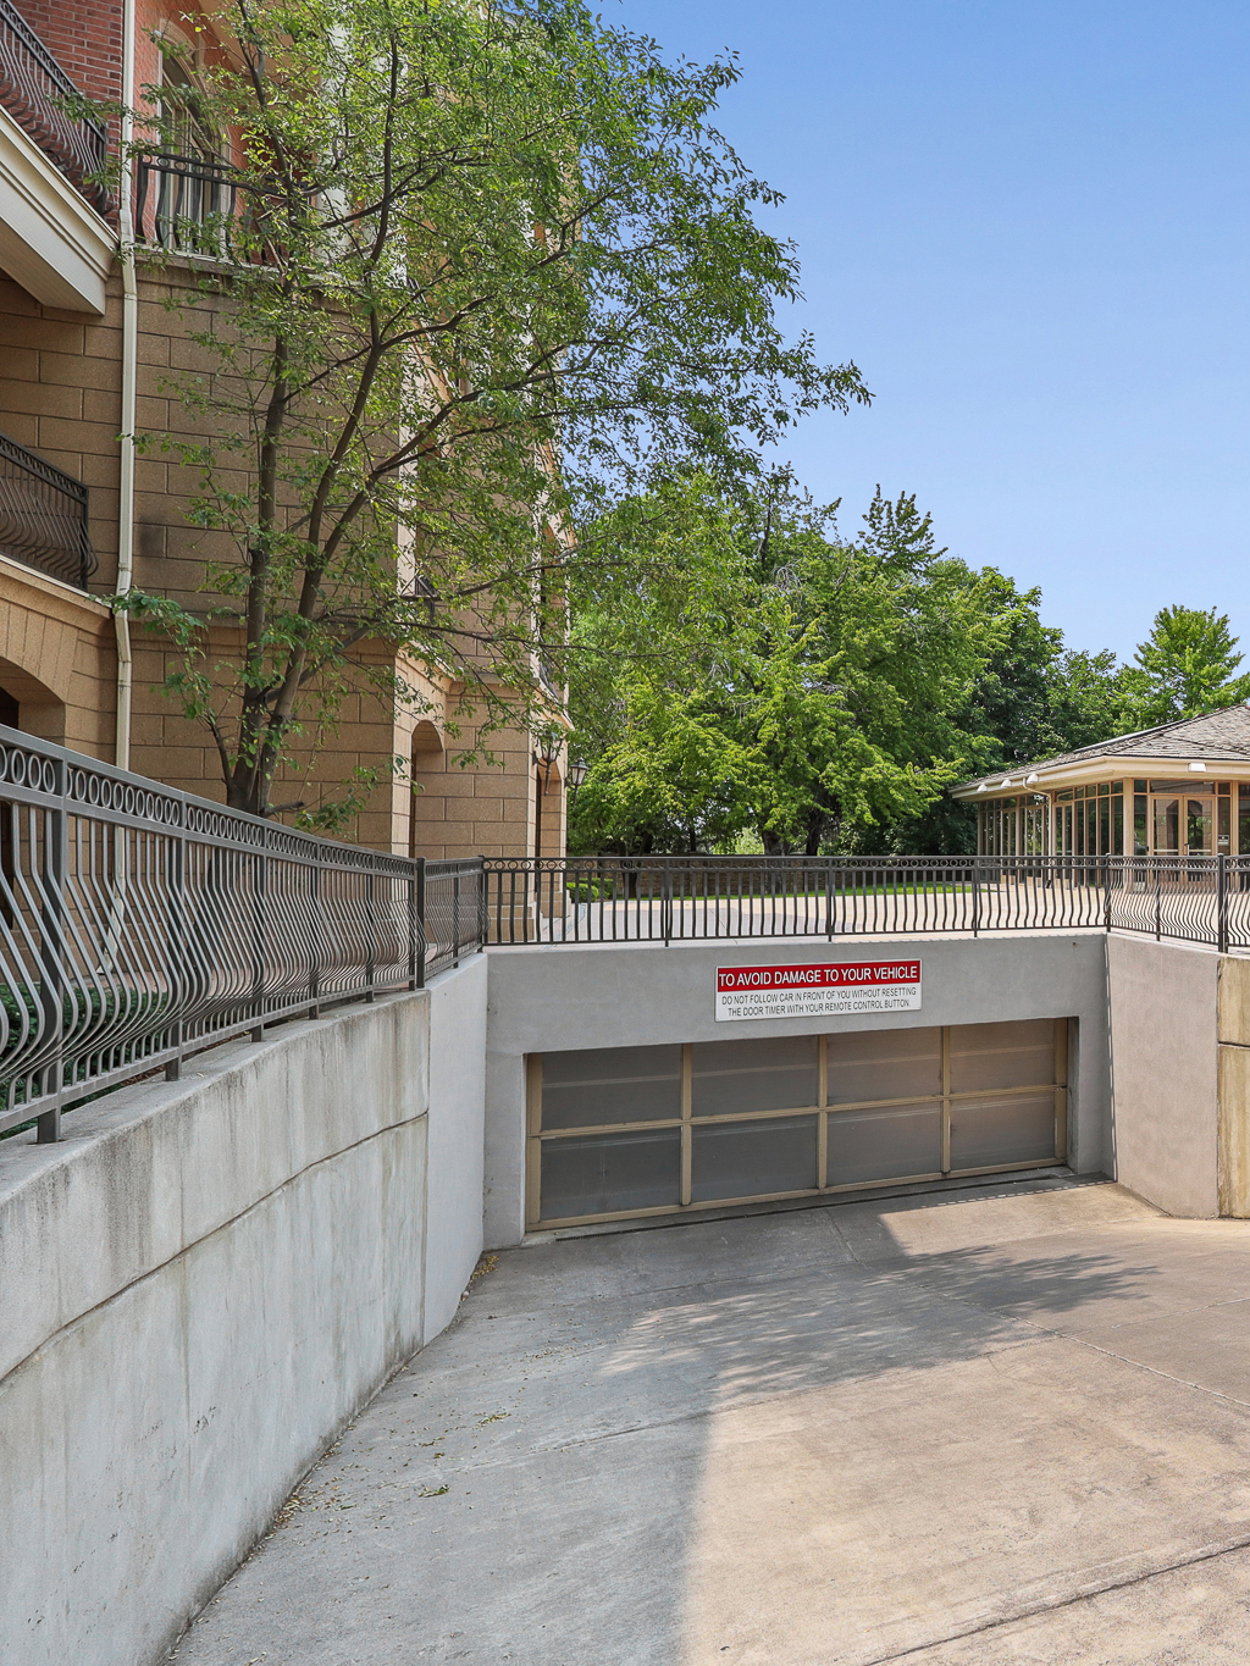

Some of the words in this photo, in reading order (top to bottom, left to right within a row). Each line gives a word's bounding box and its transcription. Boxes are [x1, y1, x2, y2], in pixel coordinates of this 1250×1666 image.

[719, 973, 735, 986] TO
[736, 972, 771, 986] AVOID
[774, 970, 822, 984] DAMAGE
[824, 968, 839, 982] TO
[841, 967, 872, 980] YOUR
[874, 966, 918, 980] VEHICLE
[722, 995, 732, 1005] DO
[734, 995, 748, 1004] NOT
[750, 994, 778, 1003] FOLLOW
[780, 992, 793, 1002] CAR
[795, 992, 801, 1001] IN
[802, 991, 824, 1001] FRONT
[826, 990, 835, 1000] OF
[837, 990, 850, 999] YOU
[852, 988, 880, 998] WITHOUT
[882, 986, 916, 997] RESETTING
[728, 1007, 742, 1016] THE
[743, 1006, 764, 1016] DOOR
[765, 1005, 786, 1014] TIMER
[787, 1004, 803, 1013] WITH
[804, 1002, 824, 1012] YOUR
[825, 1001, 852, 1012] REMOTE
[853, 1000, 882, 1010] CONTROL
